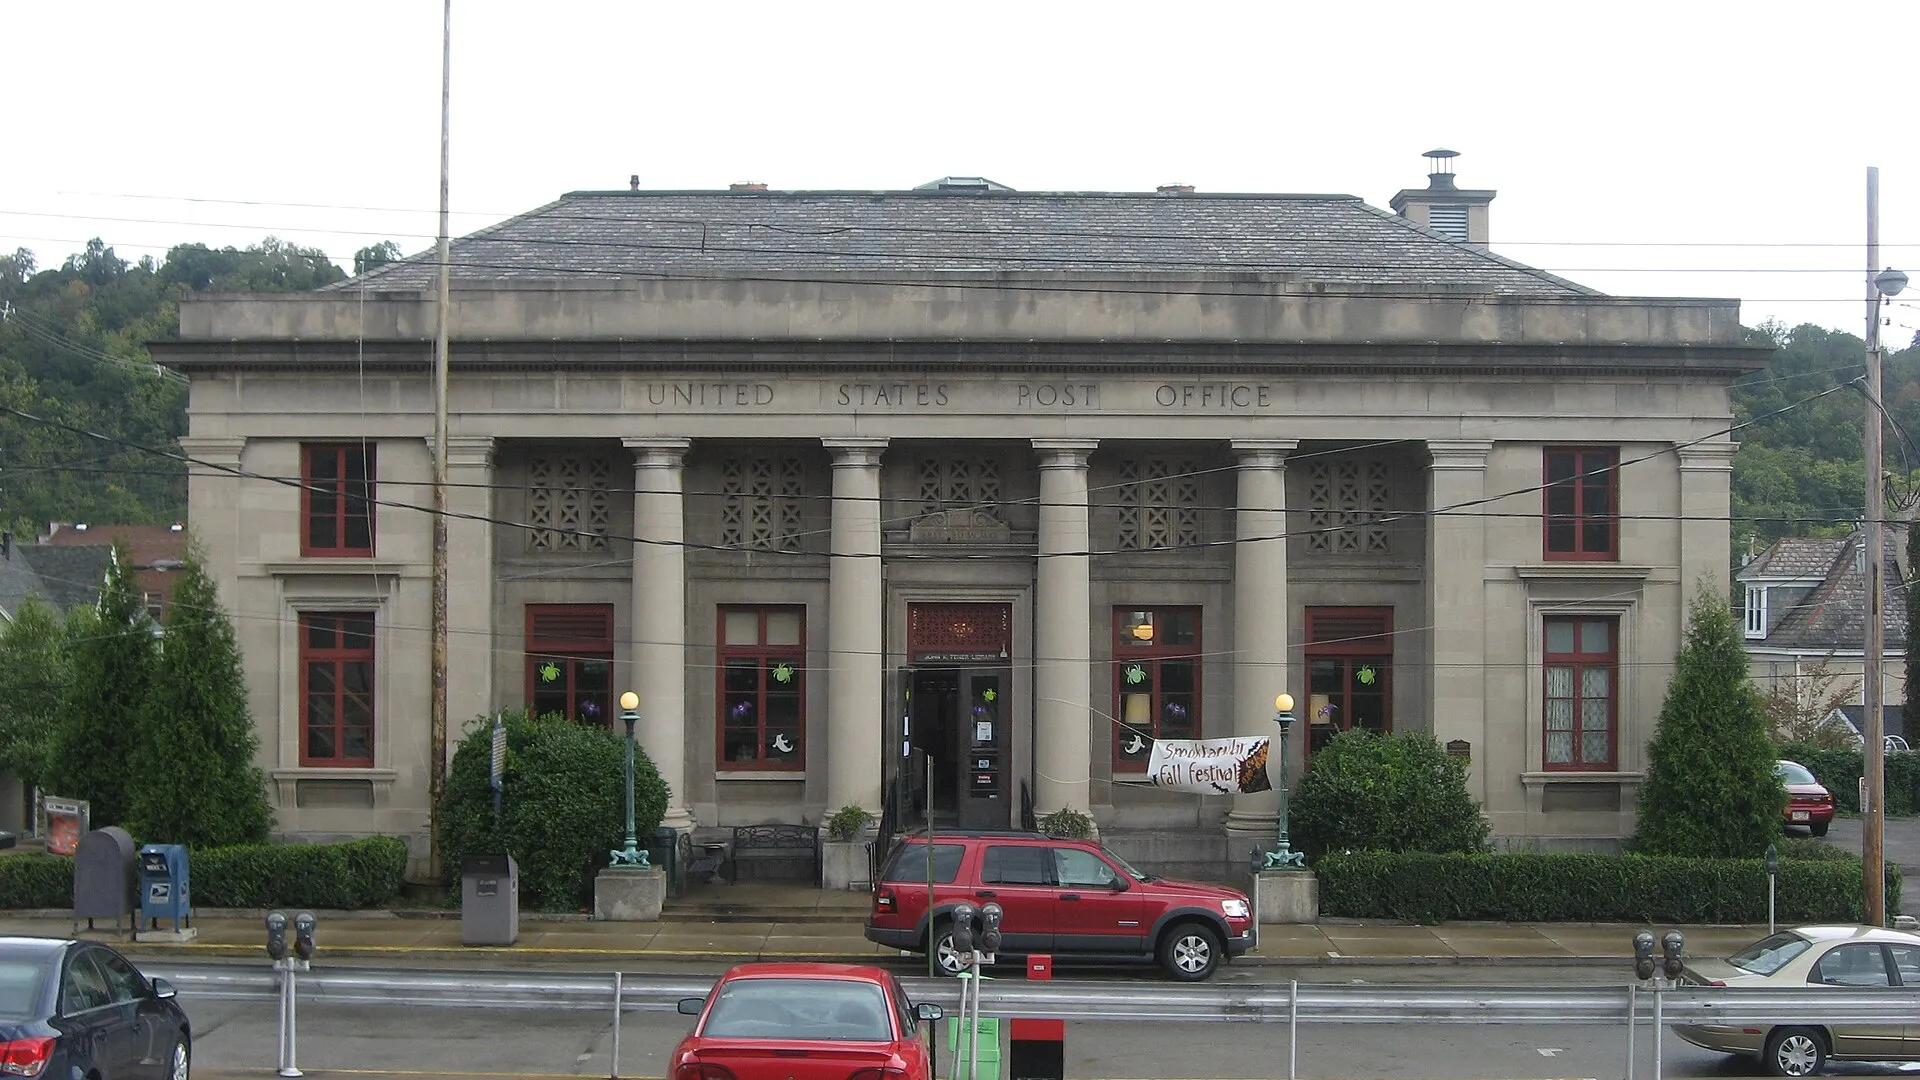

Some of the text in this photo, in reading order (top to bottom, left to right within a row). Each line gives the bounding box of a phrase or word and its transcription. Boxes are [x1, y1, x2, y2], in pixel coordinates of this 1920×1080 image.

[648, 384, 1271, 407] UNITED STATES POST OFFICE
